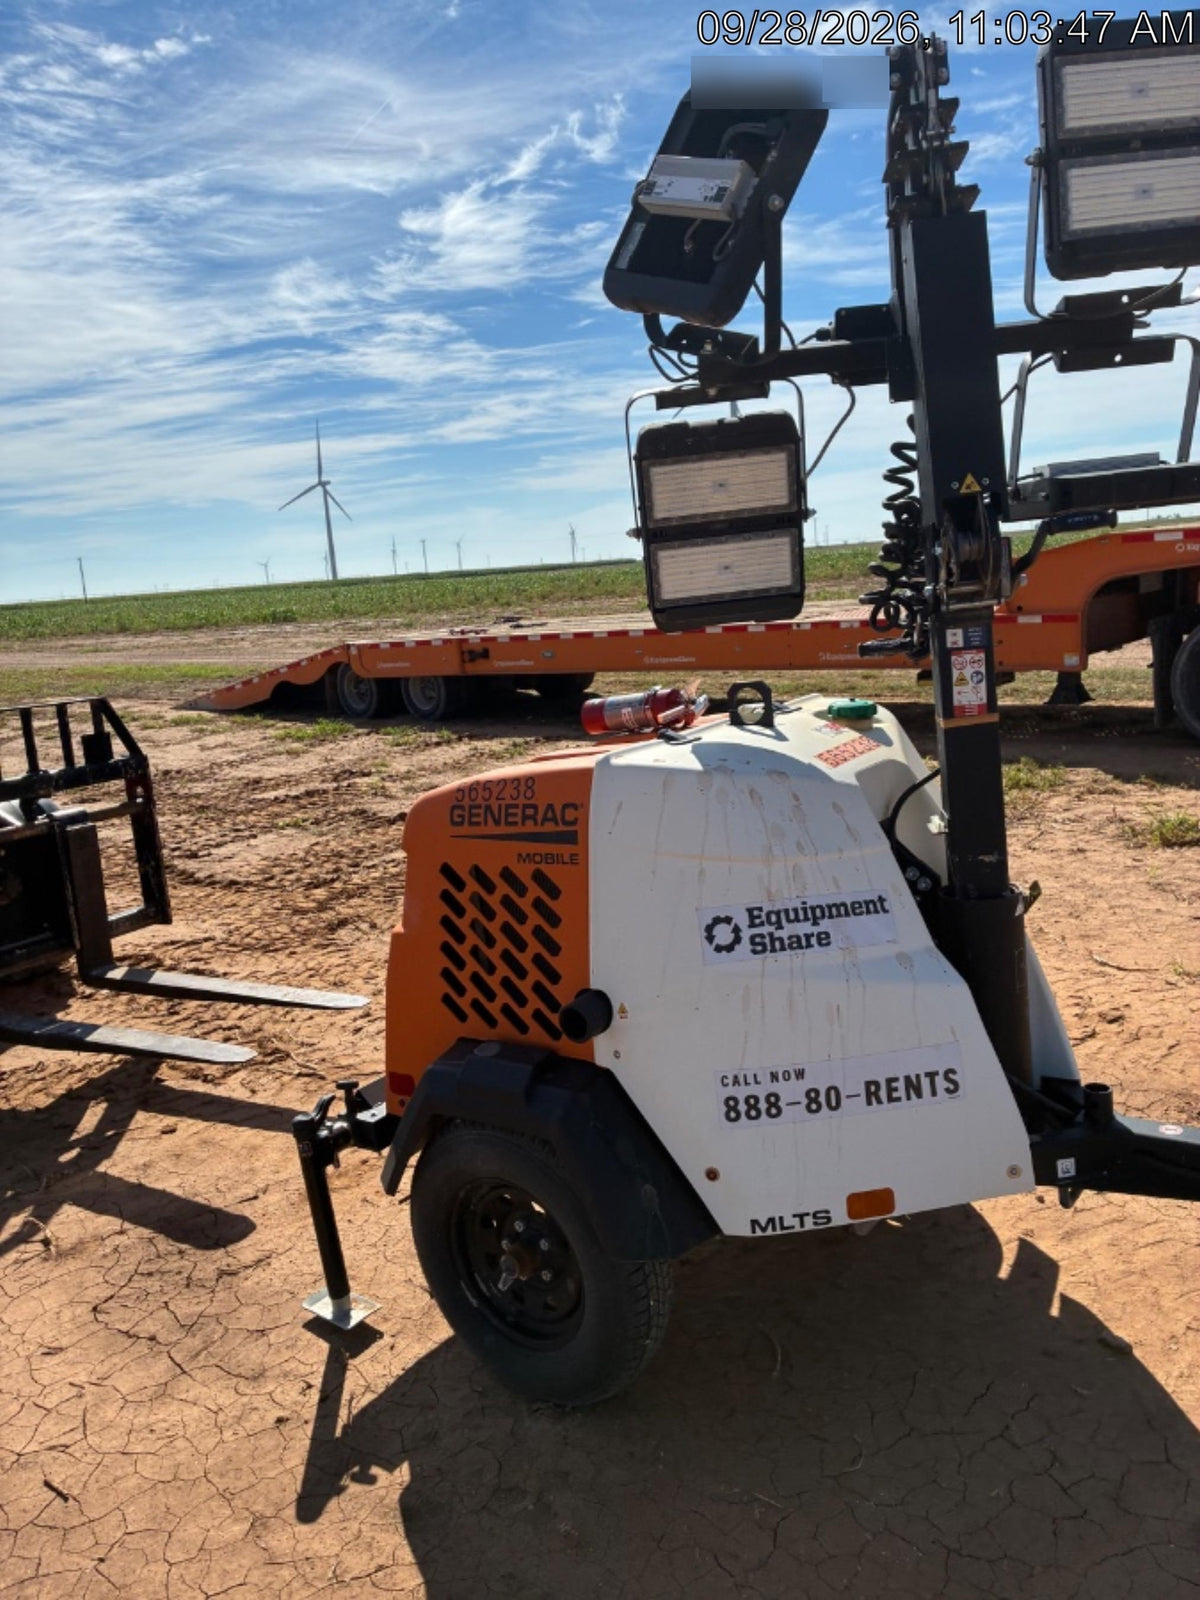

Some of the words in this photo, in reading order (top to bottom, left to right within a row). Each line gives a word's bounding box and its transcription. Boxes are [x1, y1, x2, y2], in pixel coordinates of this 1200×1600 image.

[455, 776, 536, 802] 565238
[450, 803, 579, 826] GENERAC
[516, 853, 580, 865] MOBILE
[746, 895, 889, 930] Equipment
[749, 930, 832, 955] Share
[720, 1073, 762, 1088] CALL
[769, 1068, 806, 1083] NOW
[723, 1068, 961, 1122] 888-80-RENTS
[750, 1209, 832, 1234] MLTS
